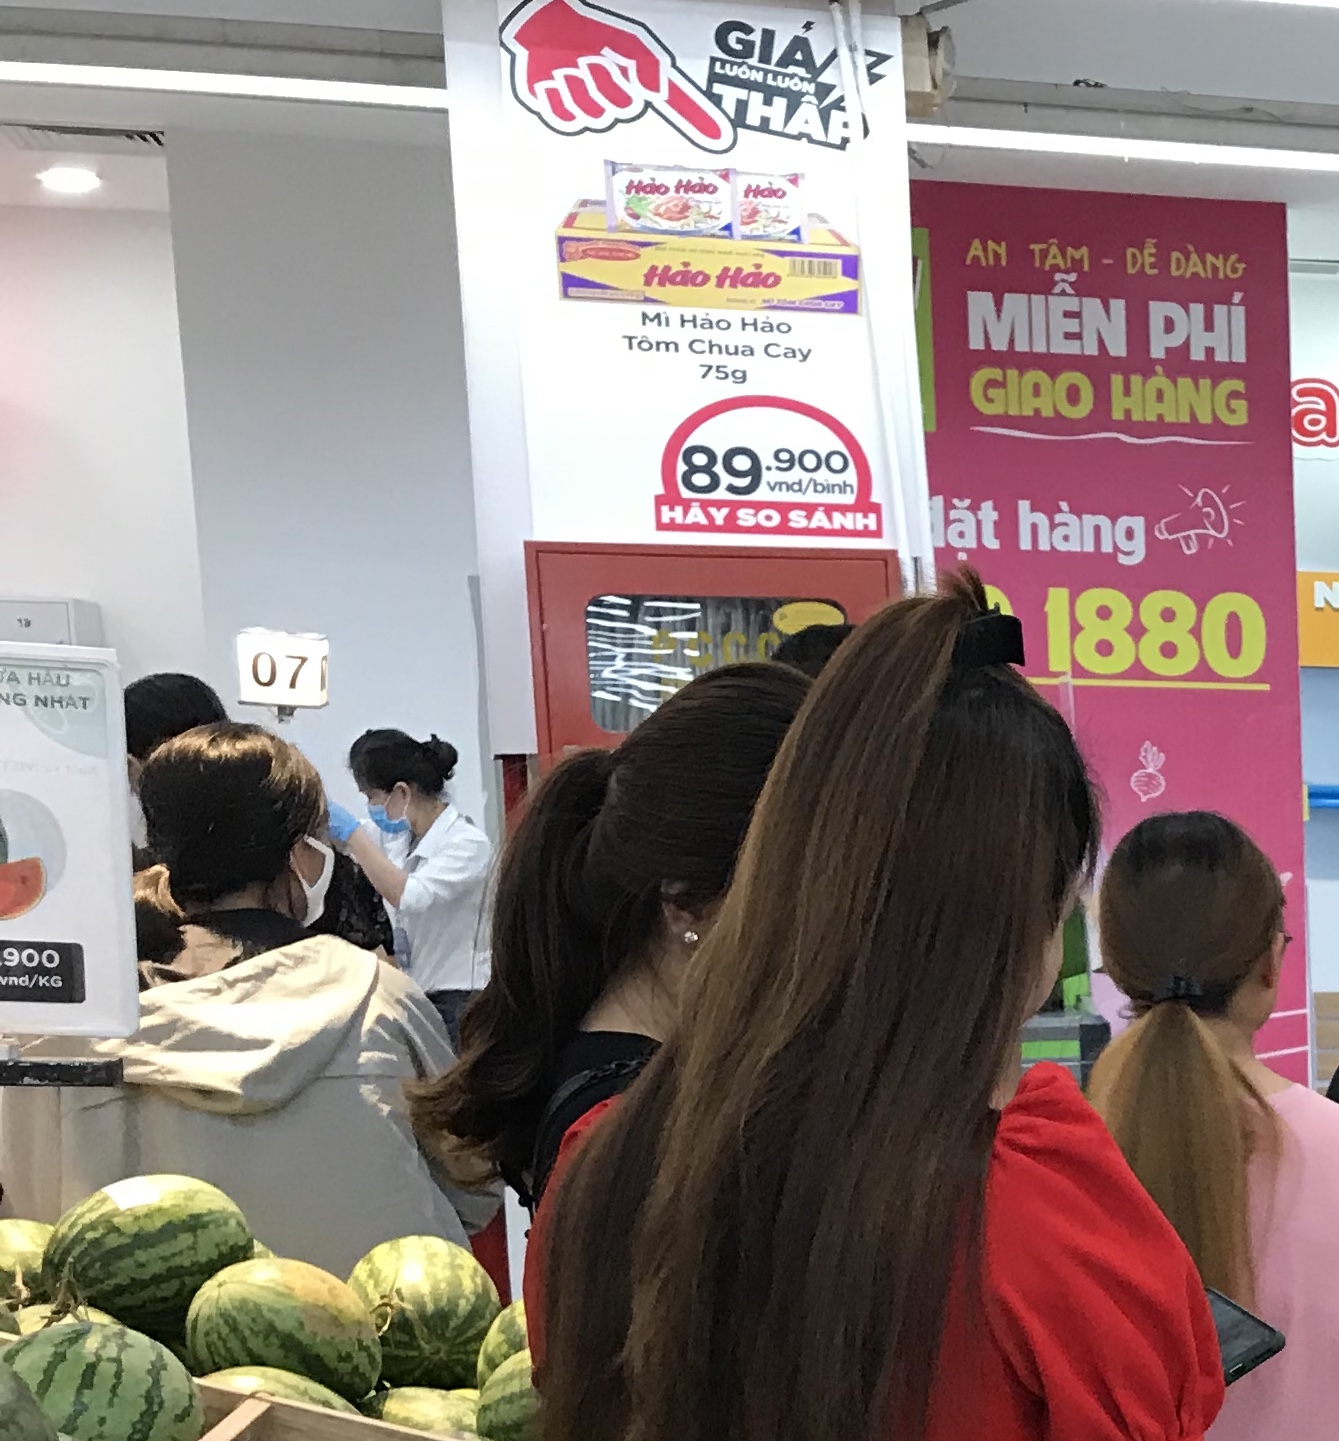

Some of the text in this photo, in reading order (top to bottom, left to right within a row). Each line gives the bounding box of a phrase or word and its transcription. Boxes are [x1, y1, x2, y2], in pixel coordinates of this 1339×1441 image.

[714, 20, 818, 70] GIÁ
[714, 61, 816, 95] LUÔN LUÔN
[643, 261, 782, 289] Hảo Hảo
[965, 239, 1007, 267] AN
[1029, 238, 1090, 272] TÂM
[1170, 244, 1247, 279] DÀNG
[640, 310, 792, 335] Mì Hảo Hảo
[967, 272, 1247, 363] MIỄN PHÍ
[622, 334, 813, 364] Tôm Chua Cay
[699, 364, 748, 385] 75g
[969, 366, 1094, 419] GIAO
[1110, 365, 1249, 426] HÀNG
[660, 502, 878, 532] HÃY SO SÁNH
[1018, 500, 1146, 566] hàng
[1044, 586, 1267, 678] 1880
[251, 652, 309, 691] 07
